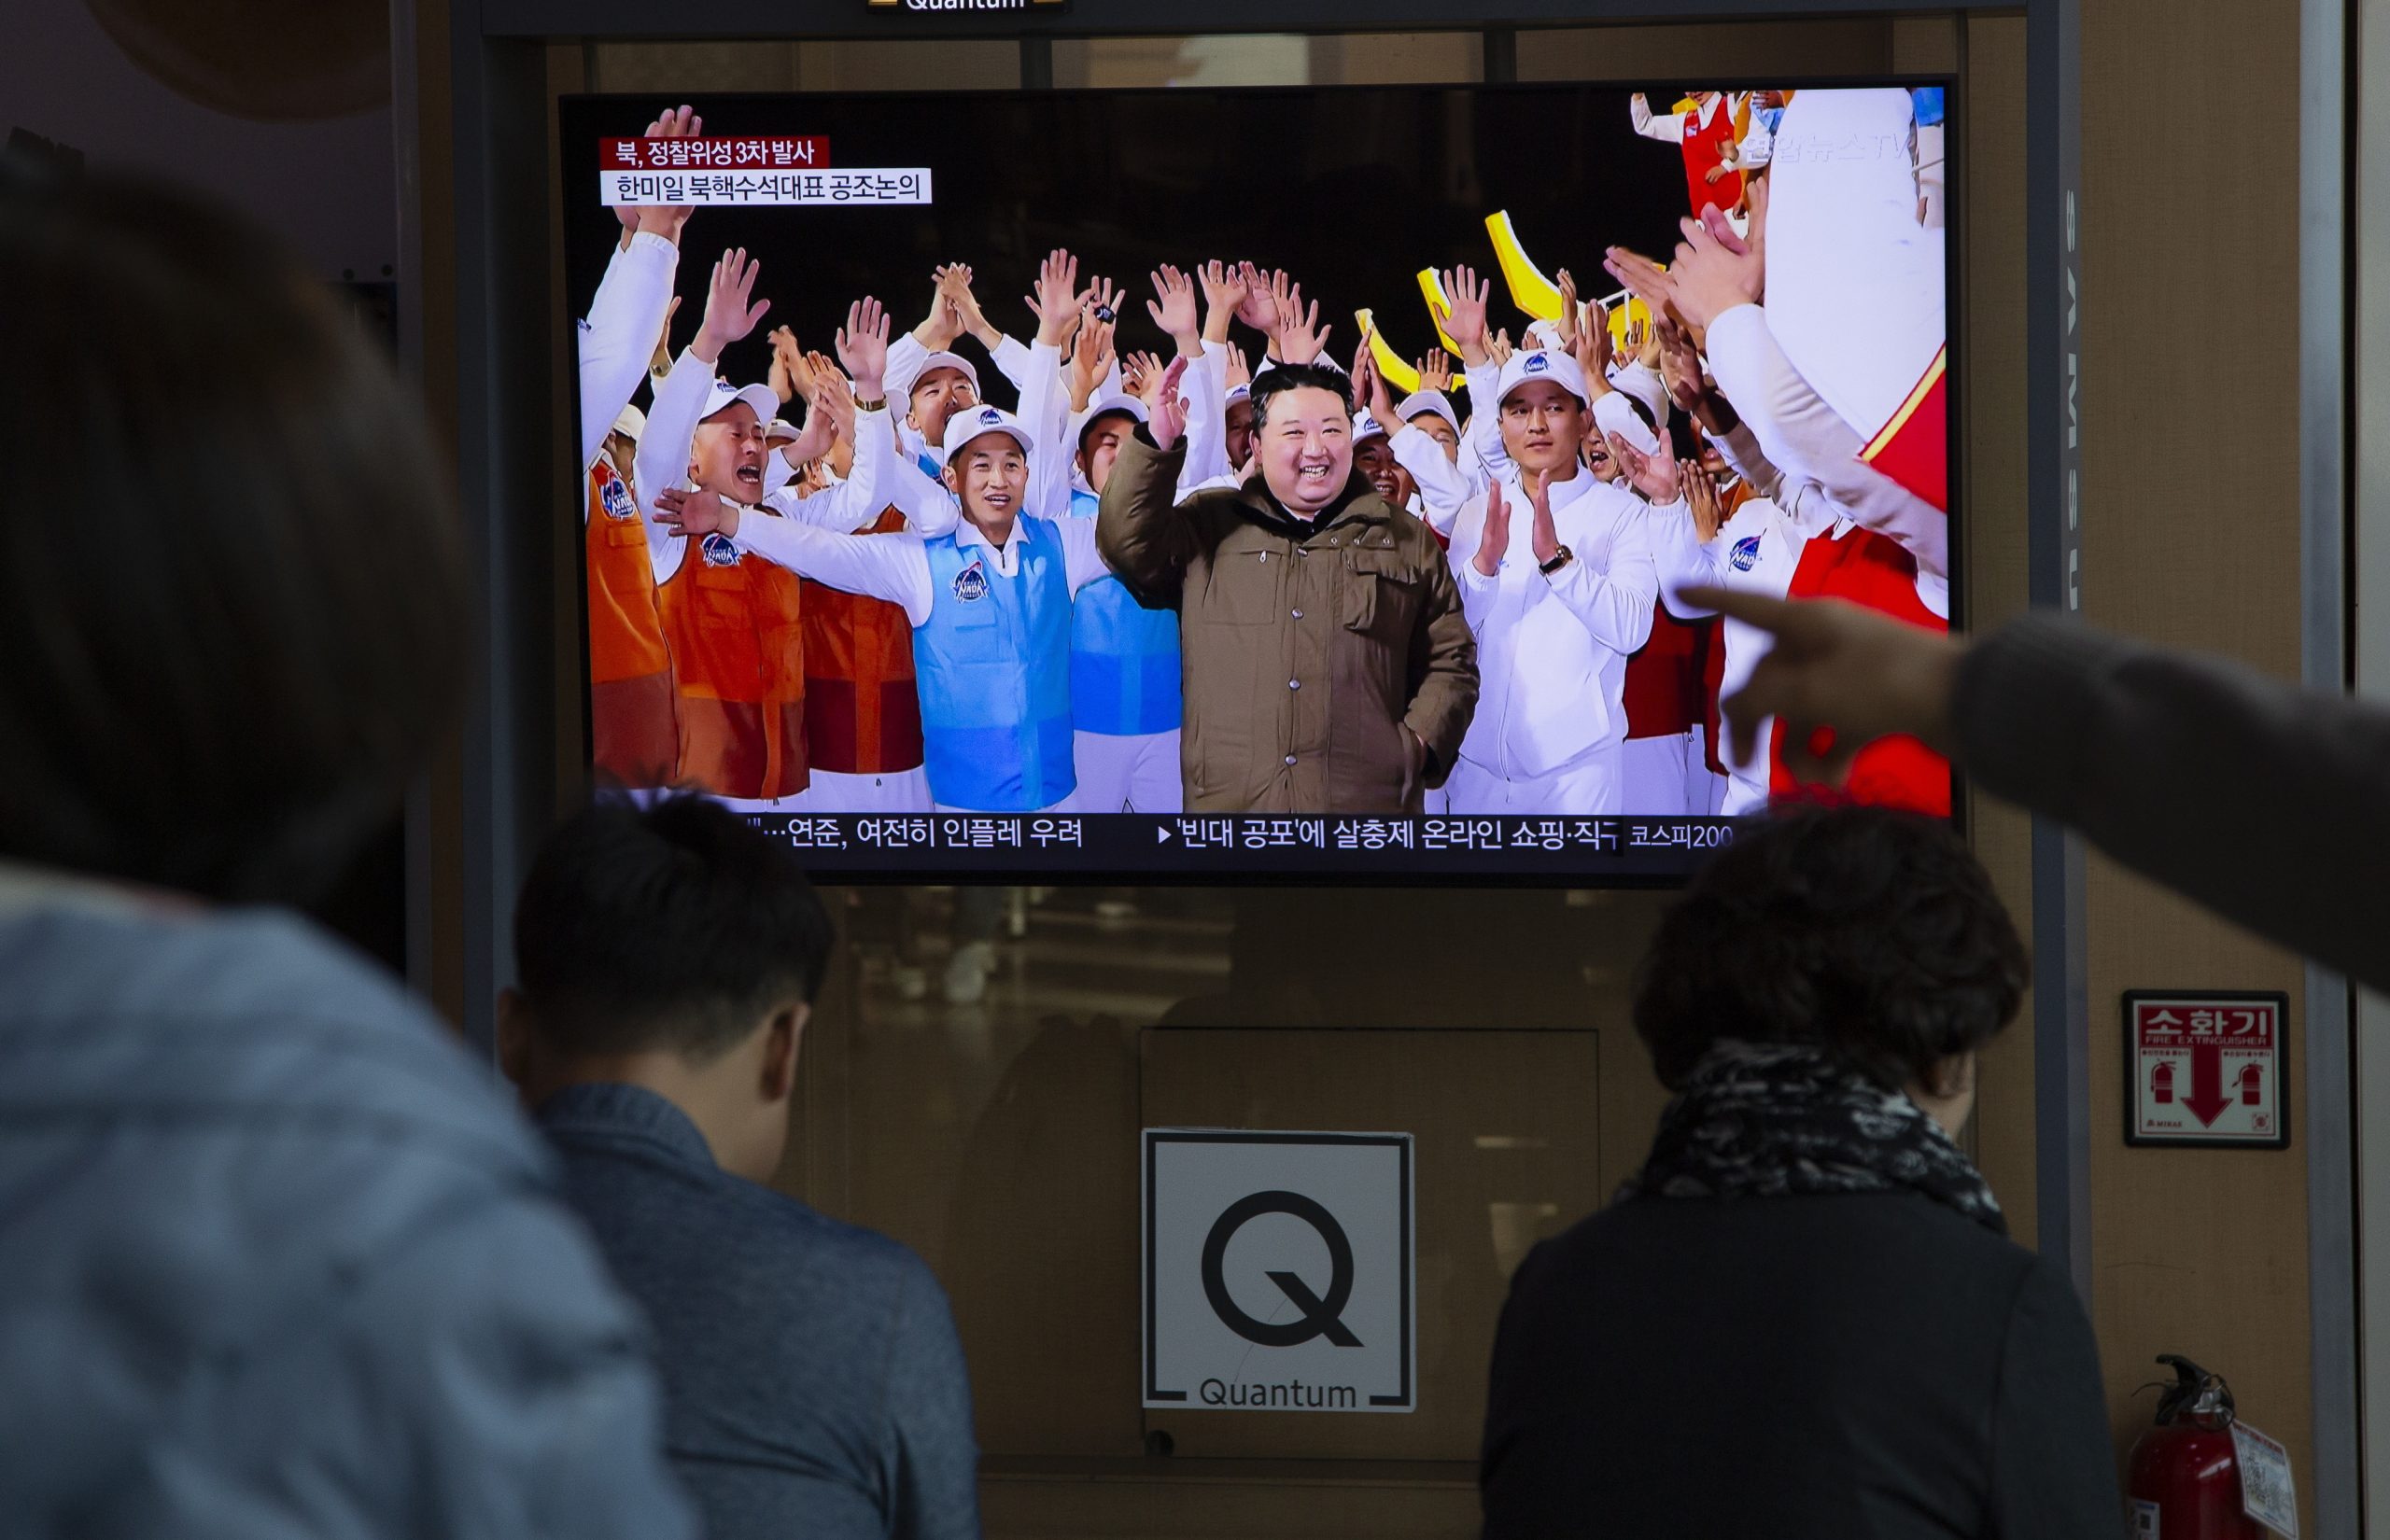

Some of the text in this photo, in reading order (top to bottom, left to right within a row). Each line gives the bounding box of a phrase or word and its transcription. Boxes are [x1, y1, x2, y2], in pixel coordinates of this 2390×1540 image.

[615, 140, 815, 168] 북, 정찰위성 3차 발사
[616, 174, 921, 203] 한미일 북핵수석대표 공조논의
[2065, 189, 2079, 611] SAMSU
[856, 819, 935, 847] 여전히
[943, 819, 1021, 847] 인플레
[1030, 819, 1082, 847] 우려
[1176, 819, 1233, 848] '빈대
[1241, 819, 1325, 849] 공포'에
[1332, 820, 1413, 849] 살충제
[1421, 820, 1503, 849] 온라인
[2145, 1009, 2268, 1036] 소화기
[2145, 1035, 2267, 1045] FIRE EXTINGUISHER
[1201, 1190, 1365, 1348] Q
[1200, 1378, 1357, 1407] Quantum
